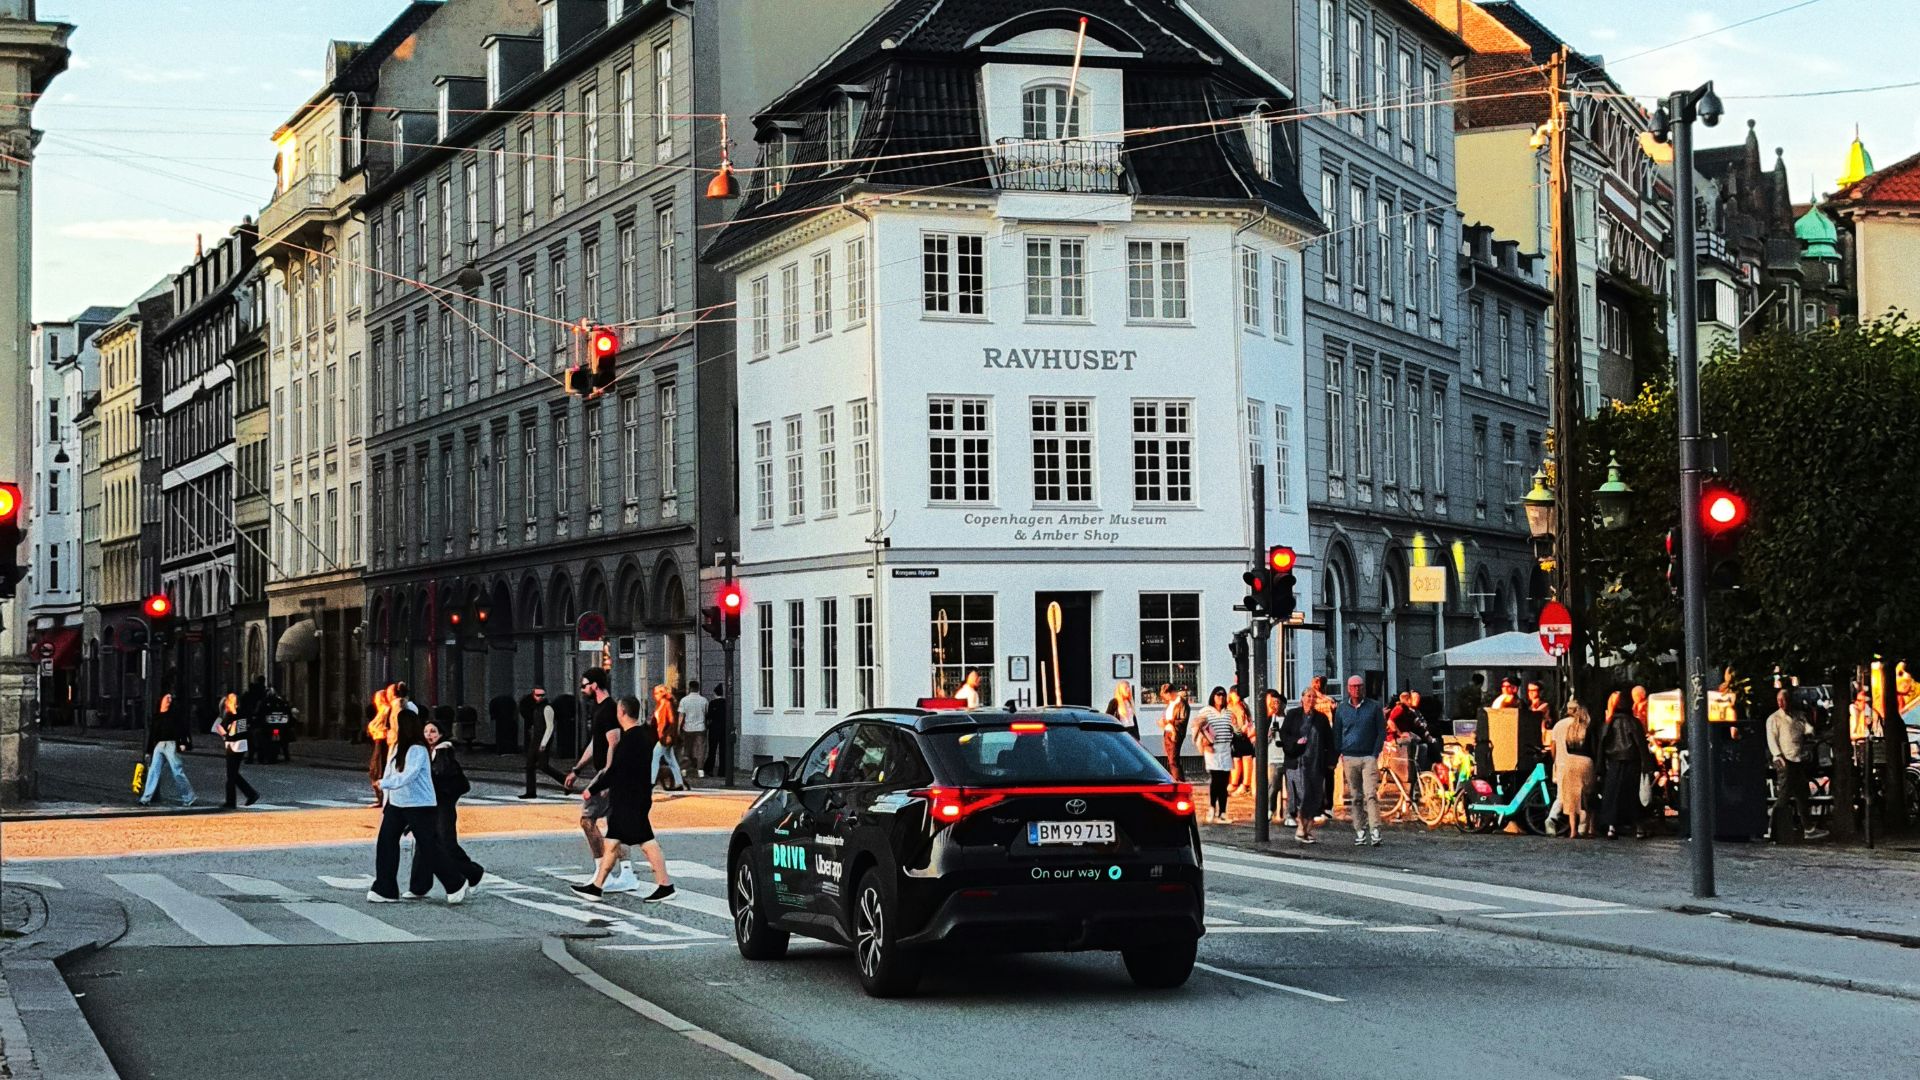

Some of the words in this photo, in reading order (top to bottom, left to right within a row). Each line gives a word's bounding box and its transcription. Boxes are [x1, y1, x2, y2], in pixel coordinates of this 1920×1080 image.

[983, 348, 1137, 371] RAVHUSET
[964, 514, 1053, 527] Copenhagen
[1058, 514, 1105, 525] Amber
[1110, 514, 1167, 525] Museum
[1014, 530, 1027, 540] &
[1032, 530, 1078, 540] Amber
[1084, 530, 1120, 543] Shop
[895, 569, 917, 577] Kongens
[918, 569, 936, 577] Nytorv
[1040, 825, 1061, 840] BM
[1064, 824, 1082, 839] 99
[1086, 824, 1113, 839] 713
[773, 843, 807, 871] DRIVR
[815, 853, 832, 877] Uber
[832, 861, 843, 882] app
[1031, 867, 1050, 879] On
[1054, 869, 1074, 879] our
[1078, 868, 1101, 881] way
